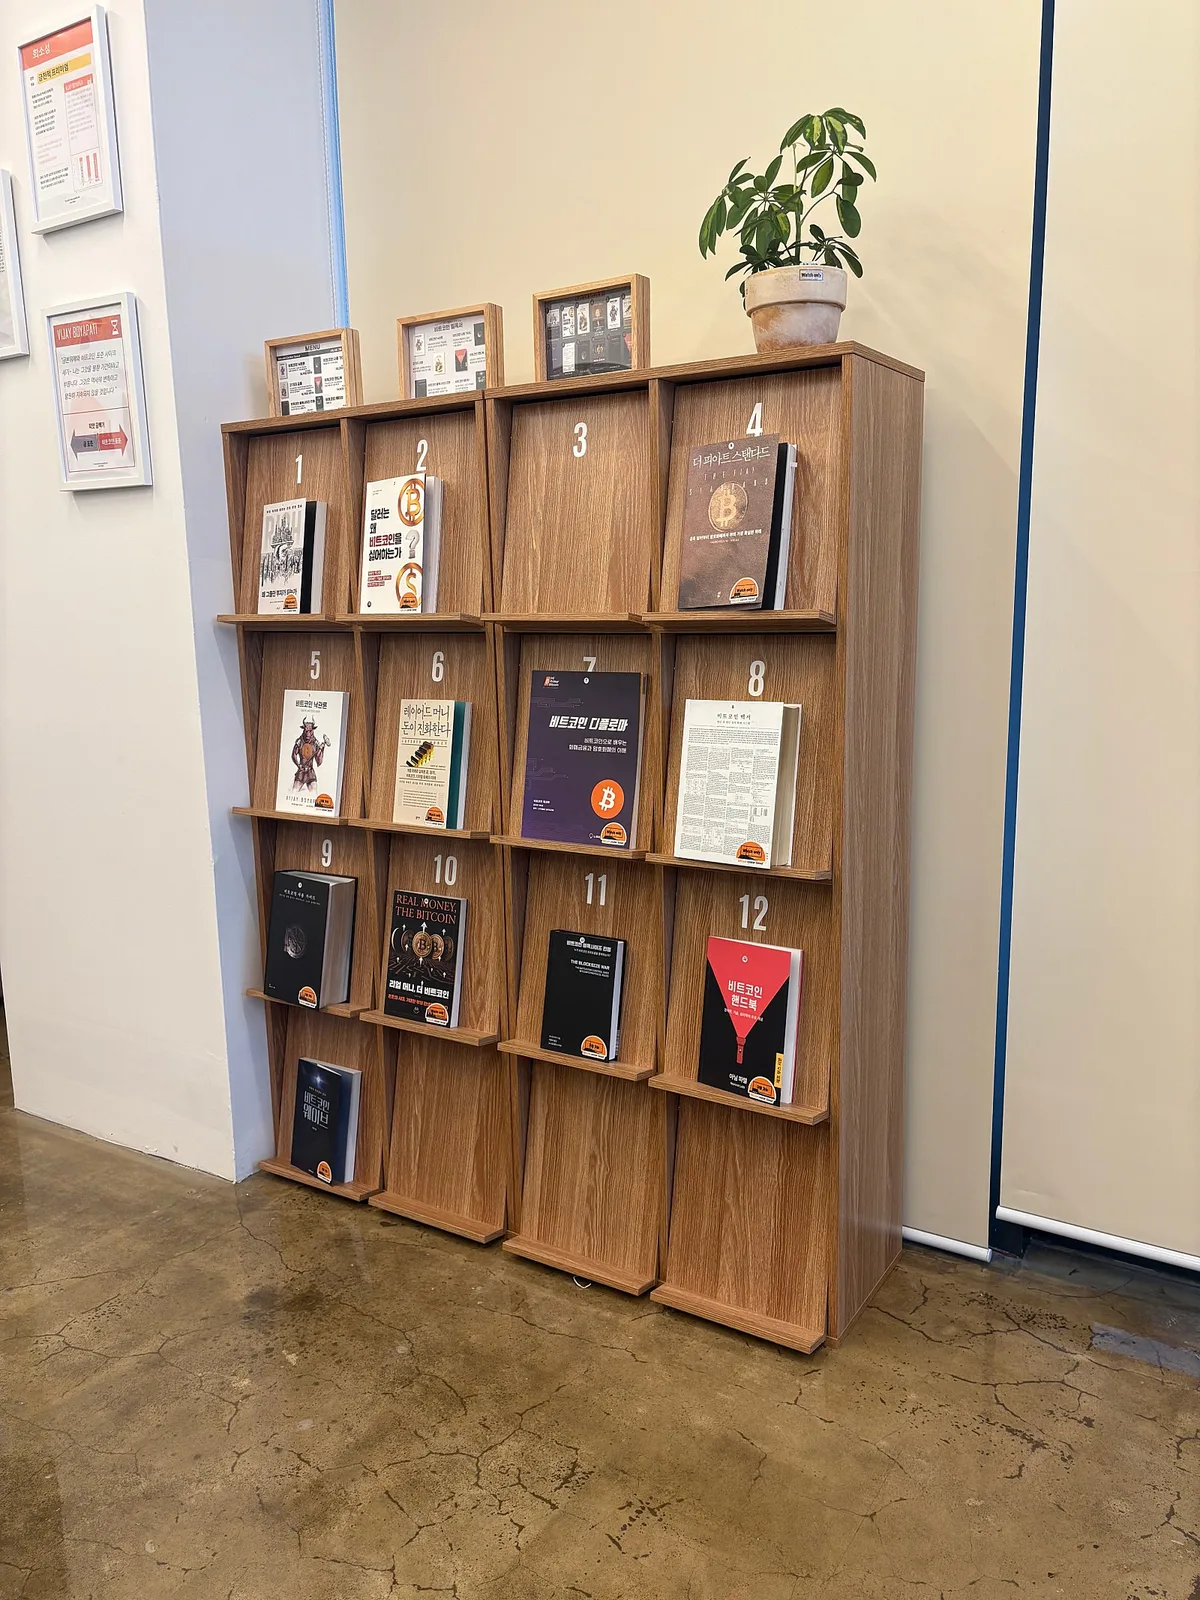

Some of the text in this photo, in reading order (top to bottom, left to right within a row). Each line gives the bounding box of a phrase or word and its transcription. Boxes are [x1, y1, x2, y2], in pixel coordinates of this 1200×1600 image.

[57, 322, 98, 341] VIJAY BOYAPATI
[304, 343, 321, 352] MENU
[745, 402, 763, 437] 4
[572, 422, 588, 458] 3
[415, 439, 428, 472] 2
[693, 445, 771, 469] 더 피아트 스탠다드
[295, 454, 303, 484] 1
[370, 508, 390, 521] 달러는
[369, 532, 402, 548] 비트코인을
[368, 547, 402, 562] 싫어하는가
[310, 651, 321, 680] 5
[431, 651, 445, 682] 6
[583, 656, 597, 673] 7
[748, 660, 765, 696] 8
[403, 704, 450, 721] 레이어드 머니
[401, 720, 451, 738] 돈이 진화한다
[549, 715, 629, 732] 비트코인 디플로마
[321, 839, 332, 868] 9
[434, 854, 458, 886] 10
[584, 872, 607, 906] 11
[396, 894, 457, 914] REAL MONEY,
[739, 894, 769, 931] 12
[395, 905, 457, 925] THE BITCOIN
[424, 986, 450, 1000] 비트코인
[728, 979, 763, 999] 비트코인
[731, 994, 757, 1012] 핸드북
